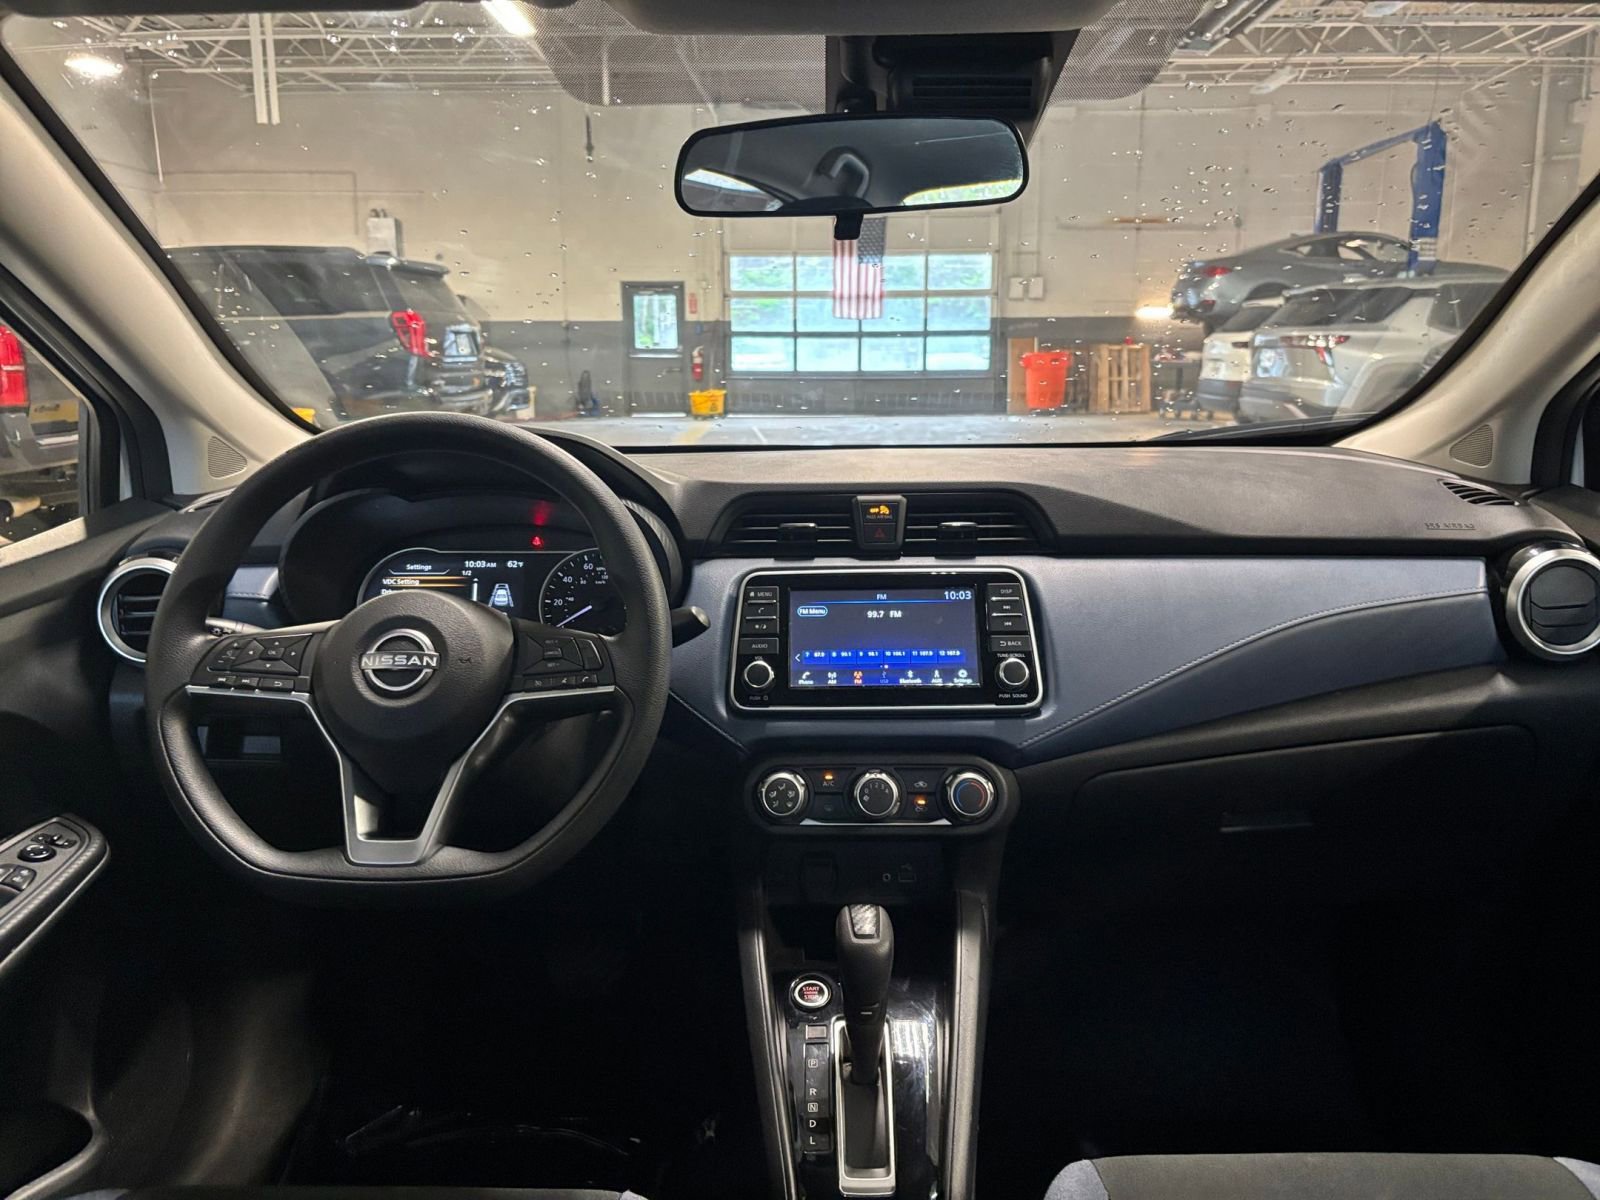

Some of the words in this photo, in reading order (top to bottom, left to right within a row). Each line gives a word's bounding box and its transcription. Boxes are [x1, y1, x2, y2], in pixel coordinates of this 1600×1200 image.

[406, 563, 432, 571] Settings
[464, 560, 486, 568] 10:03
[876, 593, 888, 601] FM
[943, 591, 972, 600] 10:03
[866, 610, 885, 618] 99.7
[889, 610, 903, 618] FM
[361, 653, 437, 668] NISSAN
[809, 1088, 817, 1096] R
[809, 1119, 817, 1128] D
[809, 1136, 816, 1145] L
